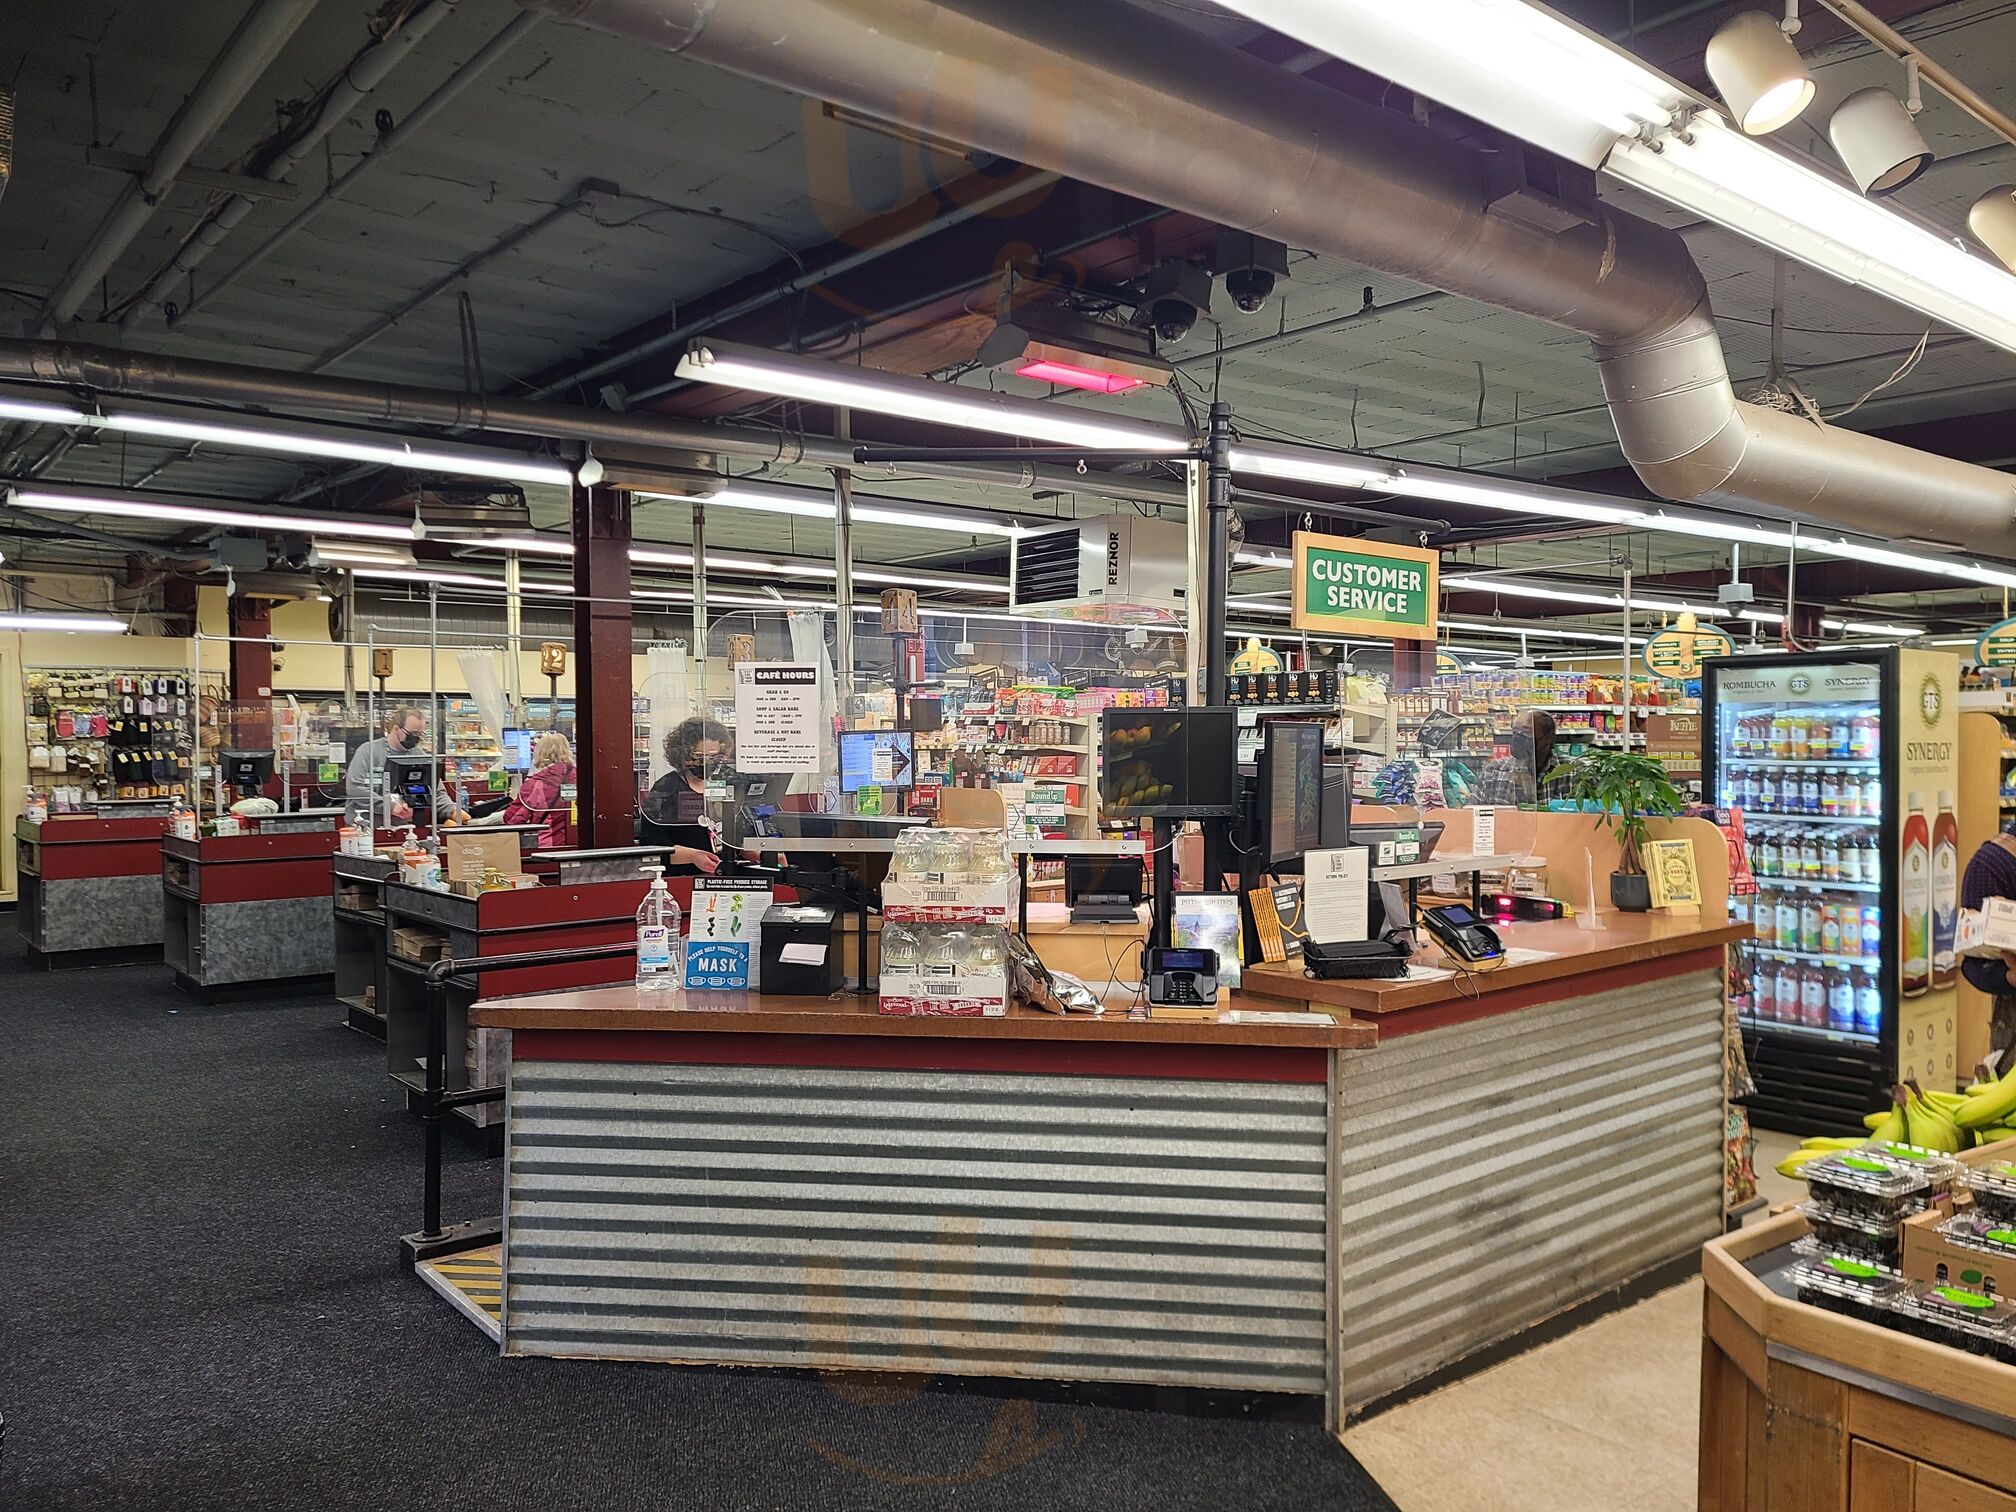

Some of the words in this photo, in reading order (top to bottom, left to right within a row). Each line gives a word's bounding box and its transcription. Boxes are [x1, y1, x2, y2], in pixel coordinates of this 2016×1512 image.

[1107, 530, 1120, 586] REZNOR
[1312, 558, 1422, 592] CUSTOMER
[1327, 586, 1408, 614] SERVICE
[902, 598, 914, 624] 4
[551, 648, 562, 666] 2
[1682, 664, 1692, 672] 3
[1723, 681, 1776, 690] KOMBUCHA
[1907, 742, 1952, 762] SYNERGY
[688, 949, 704, 962] PLEASE
[717, 946, 739, 954] YOURSELF
[698, 958, 737, 972] MASK
